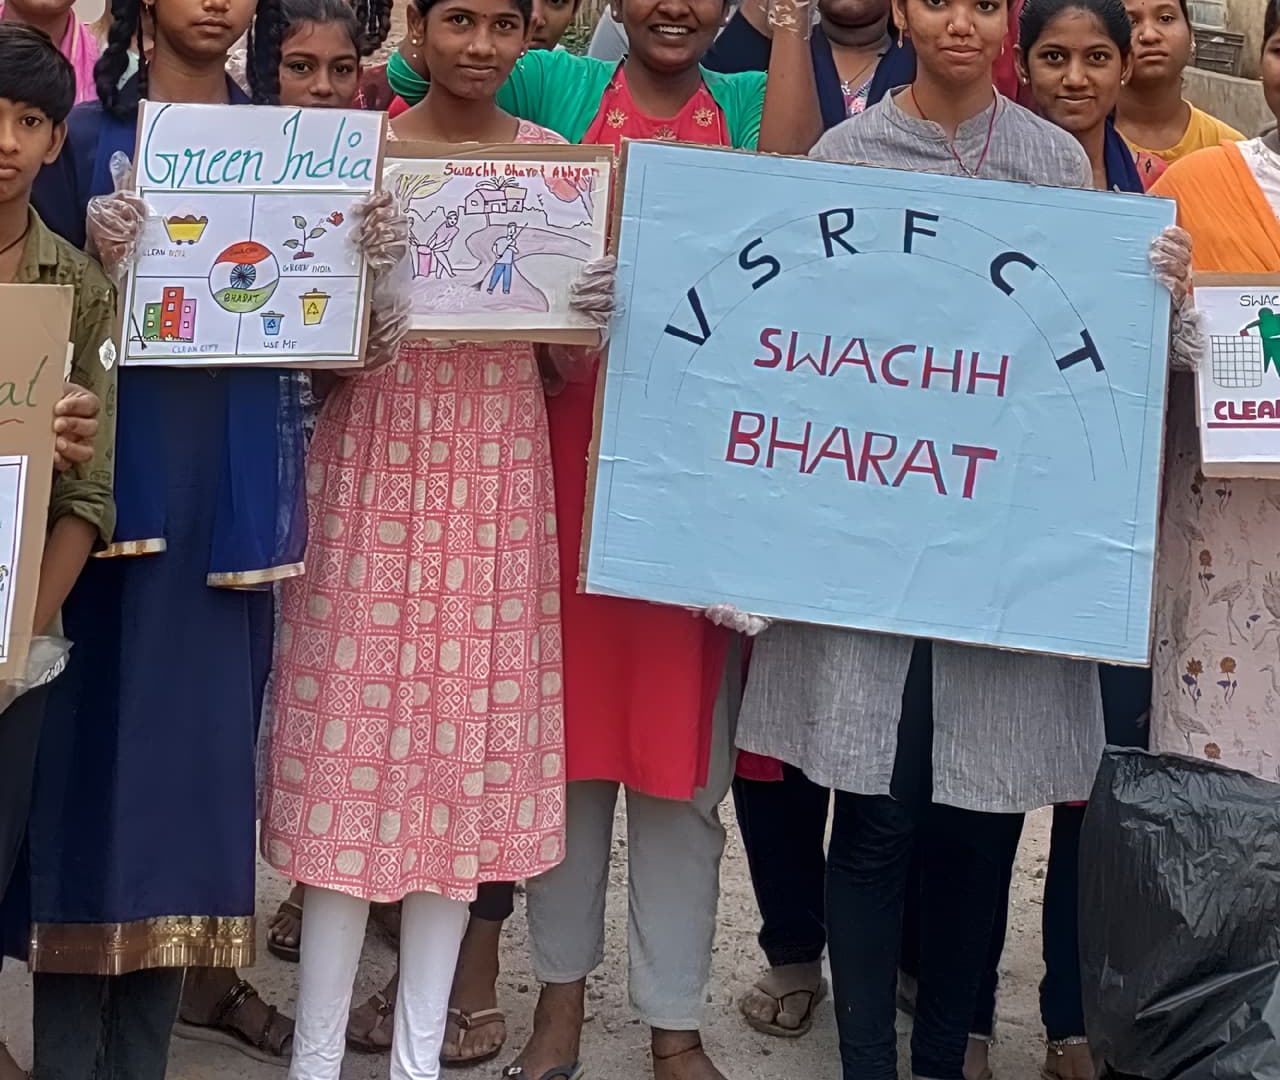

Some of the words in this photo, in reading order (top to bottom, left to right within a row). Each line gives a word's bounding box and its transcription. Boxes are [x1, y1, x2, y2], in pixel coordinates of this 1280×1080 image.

[143, 103, 265, 189] Green
[272, 110, 372, 185] India
[443, 162, 497, 178] Swachh
[753, 326, 1009, 397] SWACHH
[724, 410, 1000, 500] BHARAT
